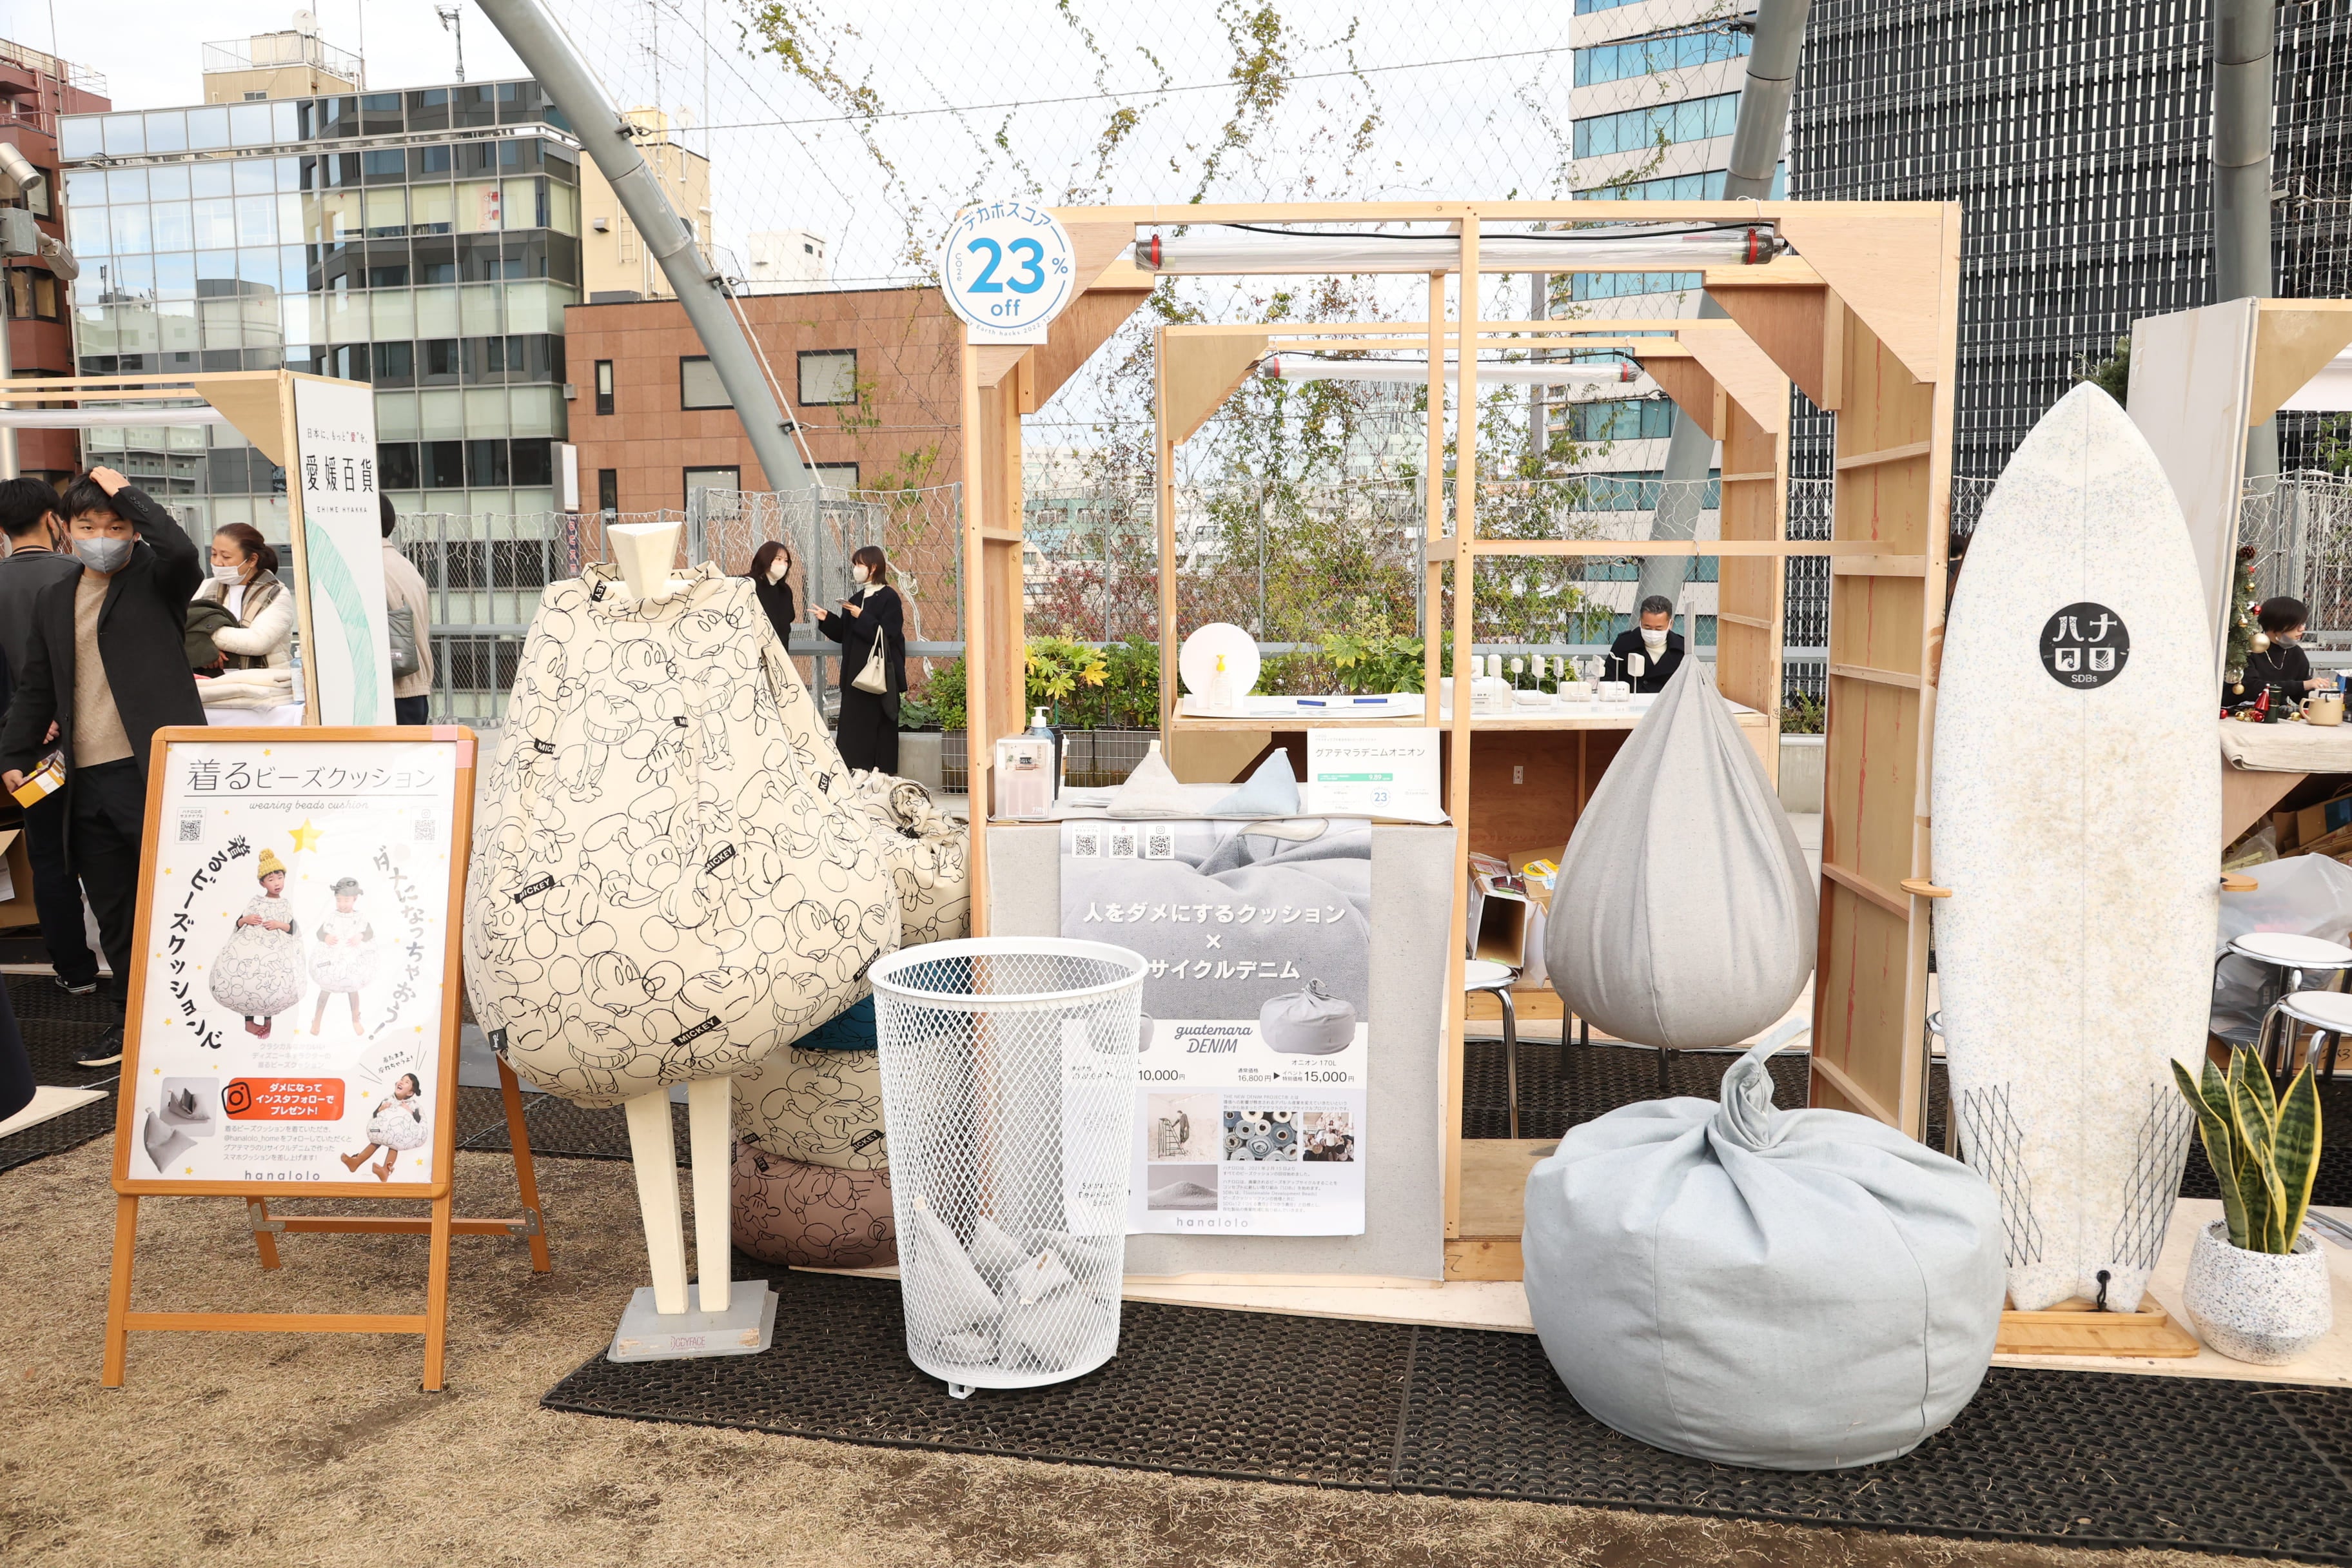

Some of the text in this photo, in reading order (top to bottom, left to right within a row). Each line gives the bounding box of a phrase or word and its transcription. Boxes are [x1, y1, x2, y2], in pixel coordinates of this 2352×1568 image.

[962, 201, 1052, 231] デカボスコア
[966, 237, 1045, 294] 23
[990, 299, 1021, 317] off
[965, 318, 974, 326] by
[975, 324, 996, 335] Earth
[1023, 315, 1052, 334] 2022.12
[306, 455, 373, 493] 愛媛百貨
[2071, 674, 2098, 683] SDBs
[1315, 748, 1426, 758] グアテマラデニムオニオン
[187, 759, 435, 790] 着るビーズクッション
[249, 799, 369, 812] wearing beads cushion
[1374, 792, 1387, 802] 23
[706, 847, 732, 872] MICKEY
[520, 878, 549, 901] MICKEY
[1083, 902, 1346, 924] 人をダメにするクッション
[678, 1019, 714, 1043] MICKEY
[1175, 1023, 1253, 1043] guatemara
[1186, 1038, 1238, 1054] DENIM
[270, 1083, 322, 1093] ダメになって
[256, 1095, 335, 1104] インスタフォローで
[271, 1106, 318, 1115] プレゼント!
[853, 1133, 877, 1151] ICKEY
[244, 1171, 320, 1181] hanalolo
[1177, 1217, 1248, 1228] hanalolo
